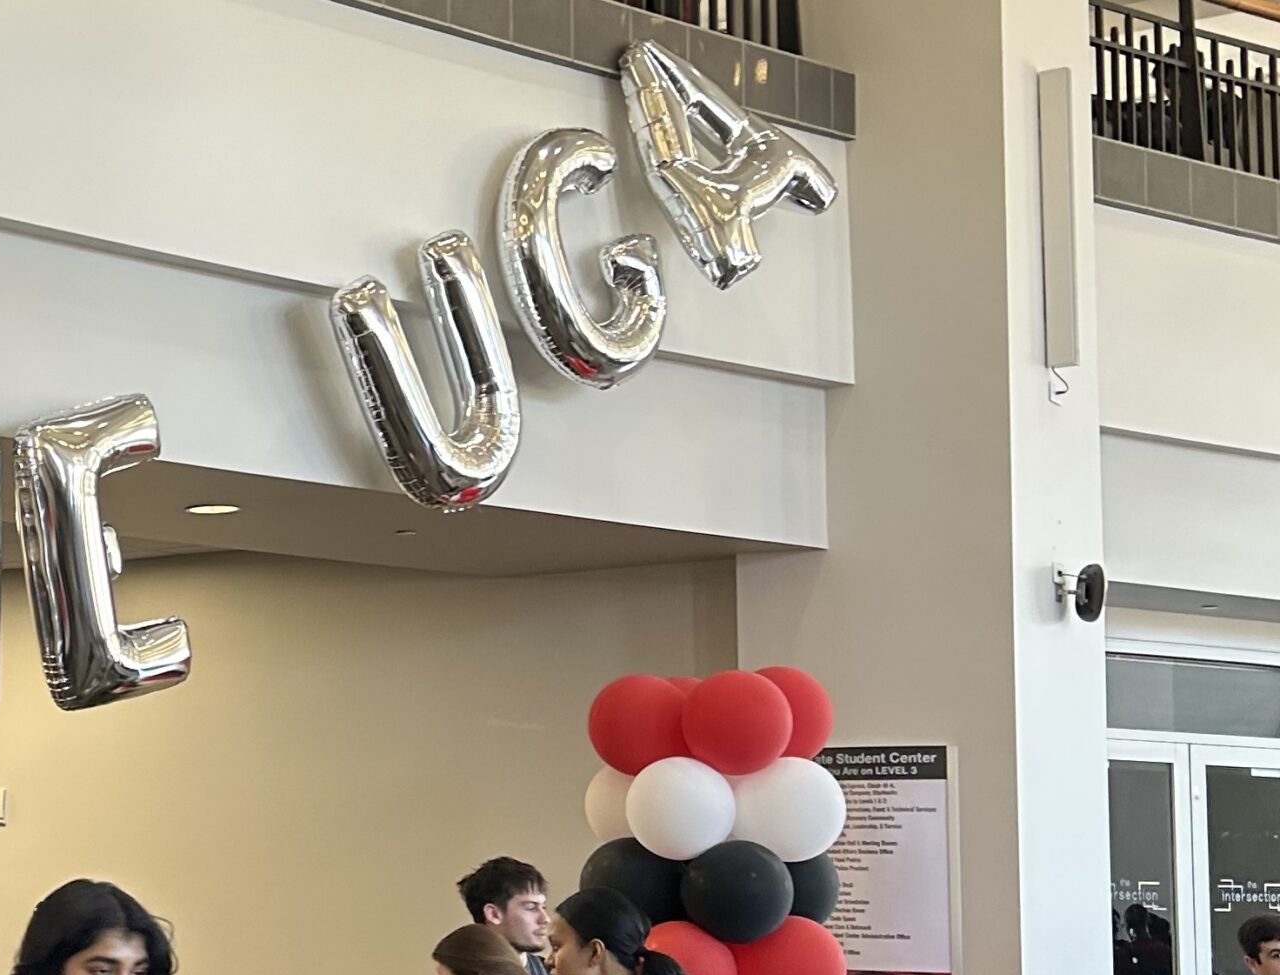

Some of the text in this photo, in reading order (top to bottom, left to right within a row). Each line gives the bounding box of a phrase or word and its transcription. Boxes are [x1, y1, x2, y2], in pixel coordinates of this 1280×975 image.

[329, 38, 839, 513] UGA
[836, 752, 886, 764] Student
[889, 752, 937, 763] Center
[842, 767, 858, 775] Are
[875, 766, 909, 775] LEVEL
[910, 766, 918, 775] 3
